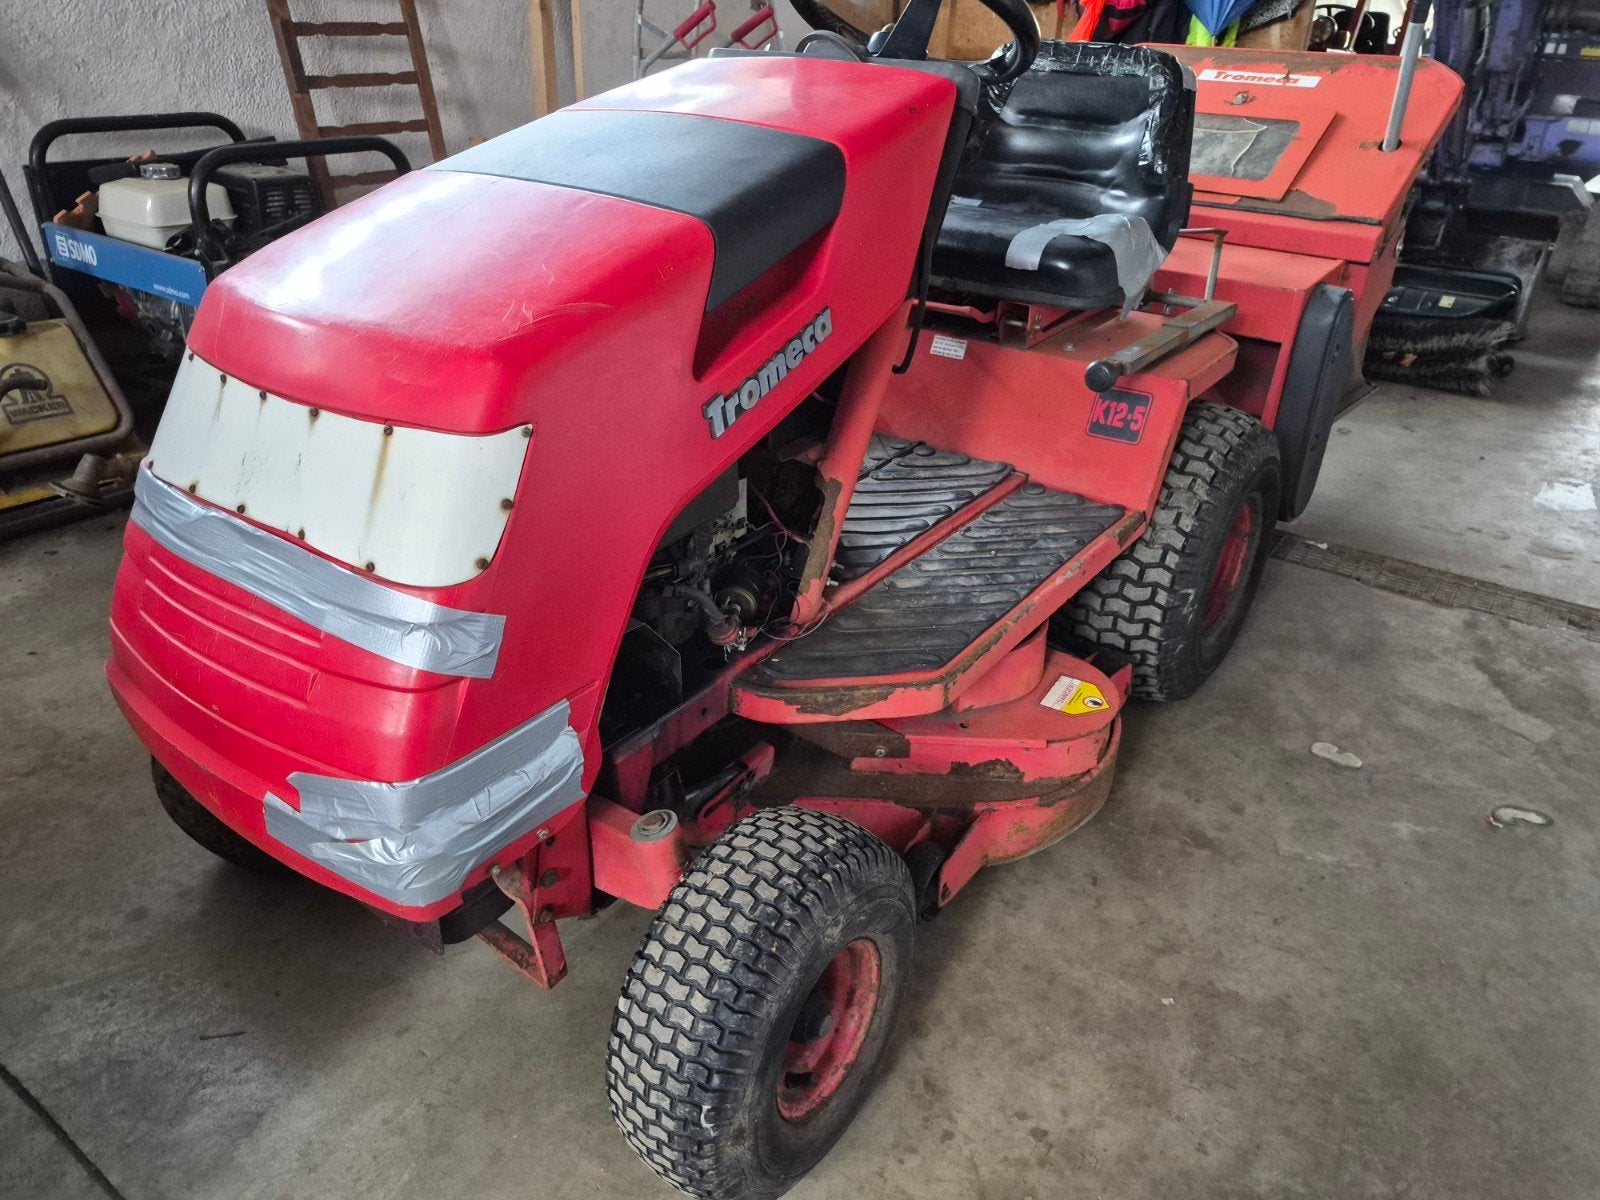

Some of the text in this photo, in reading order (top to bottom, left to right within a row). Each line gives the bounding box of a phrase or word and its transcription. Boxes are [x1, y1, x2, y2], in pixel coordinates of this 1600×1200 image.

[68, 238, 97, 266] SDMO
[702, 305, 832, 439] Tromeca
[9, 401, 66, 417] WACKER
